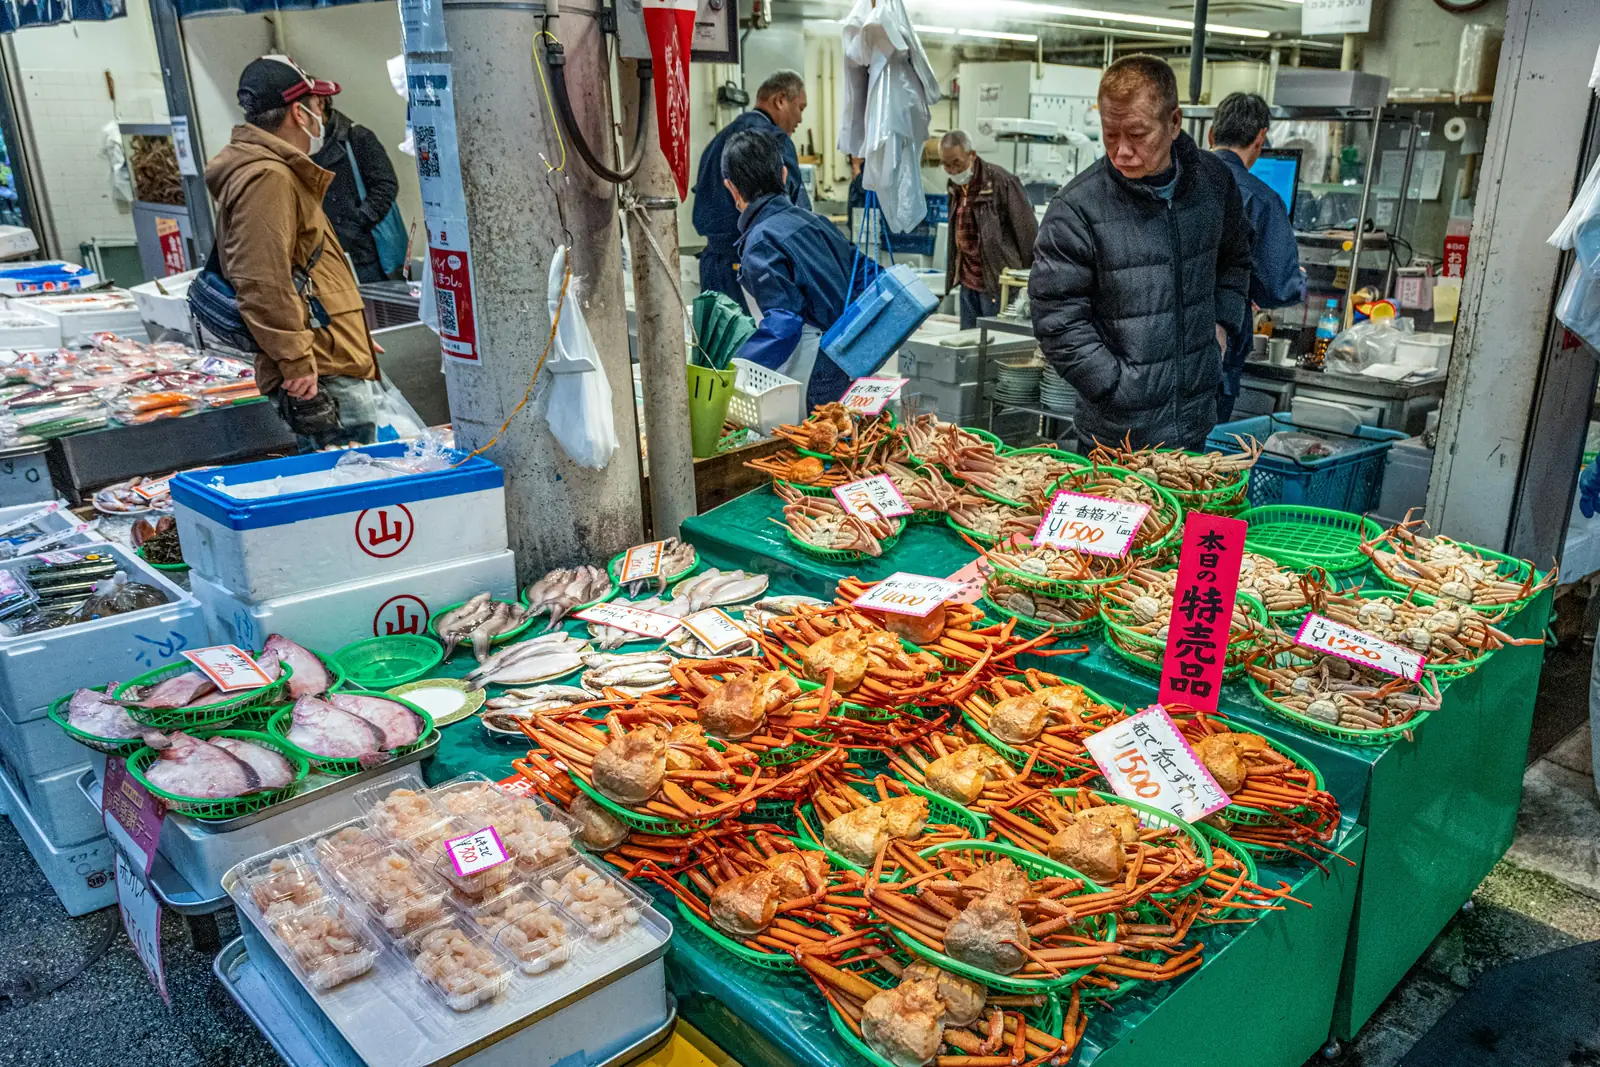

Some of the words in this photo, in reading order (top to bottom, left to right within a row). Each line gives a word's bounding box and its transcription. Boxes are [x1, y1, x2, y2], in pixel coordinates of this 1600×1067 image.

[1055, 501, 1070, 515] 生
[1075, 504, 1130, 524] 香箱ガニ
[368, 511, 402, 546] 山
[1046, 517, 1104, 544] ¥1500
[385, 605, 418, 635] 山
[1169, 530, 1227, 698] 本日の特売品
[1312, 629, 1382, 660] ¥1500
